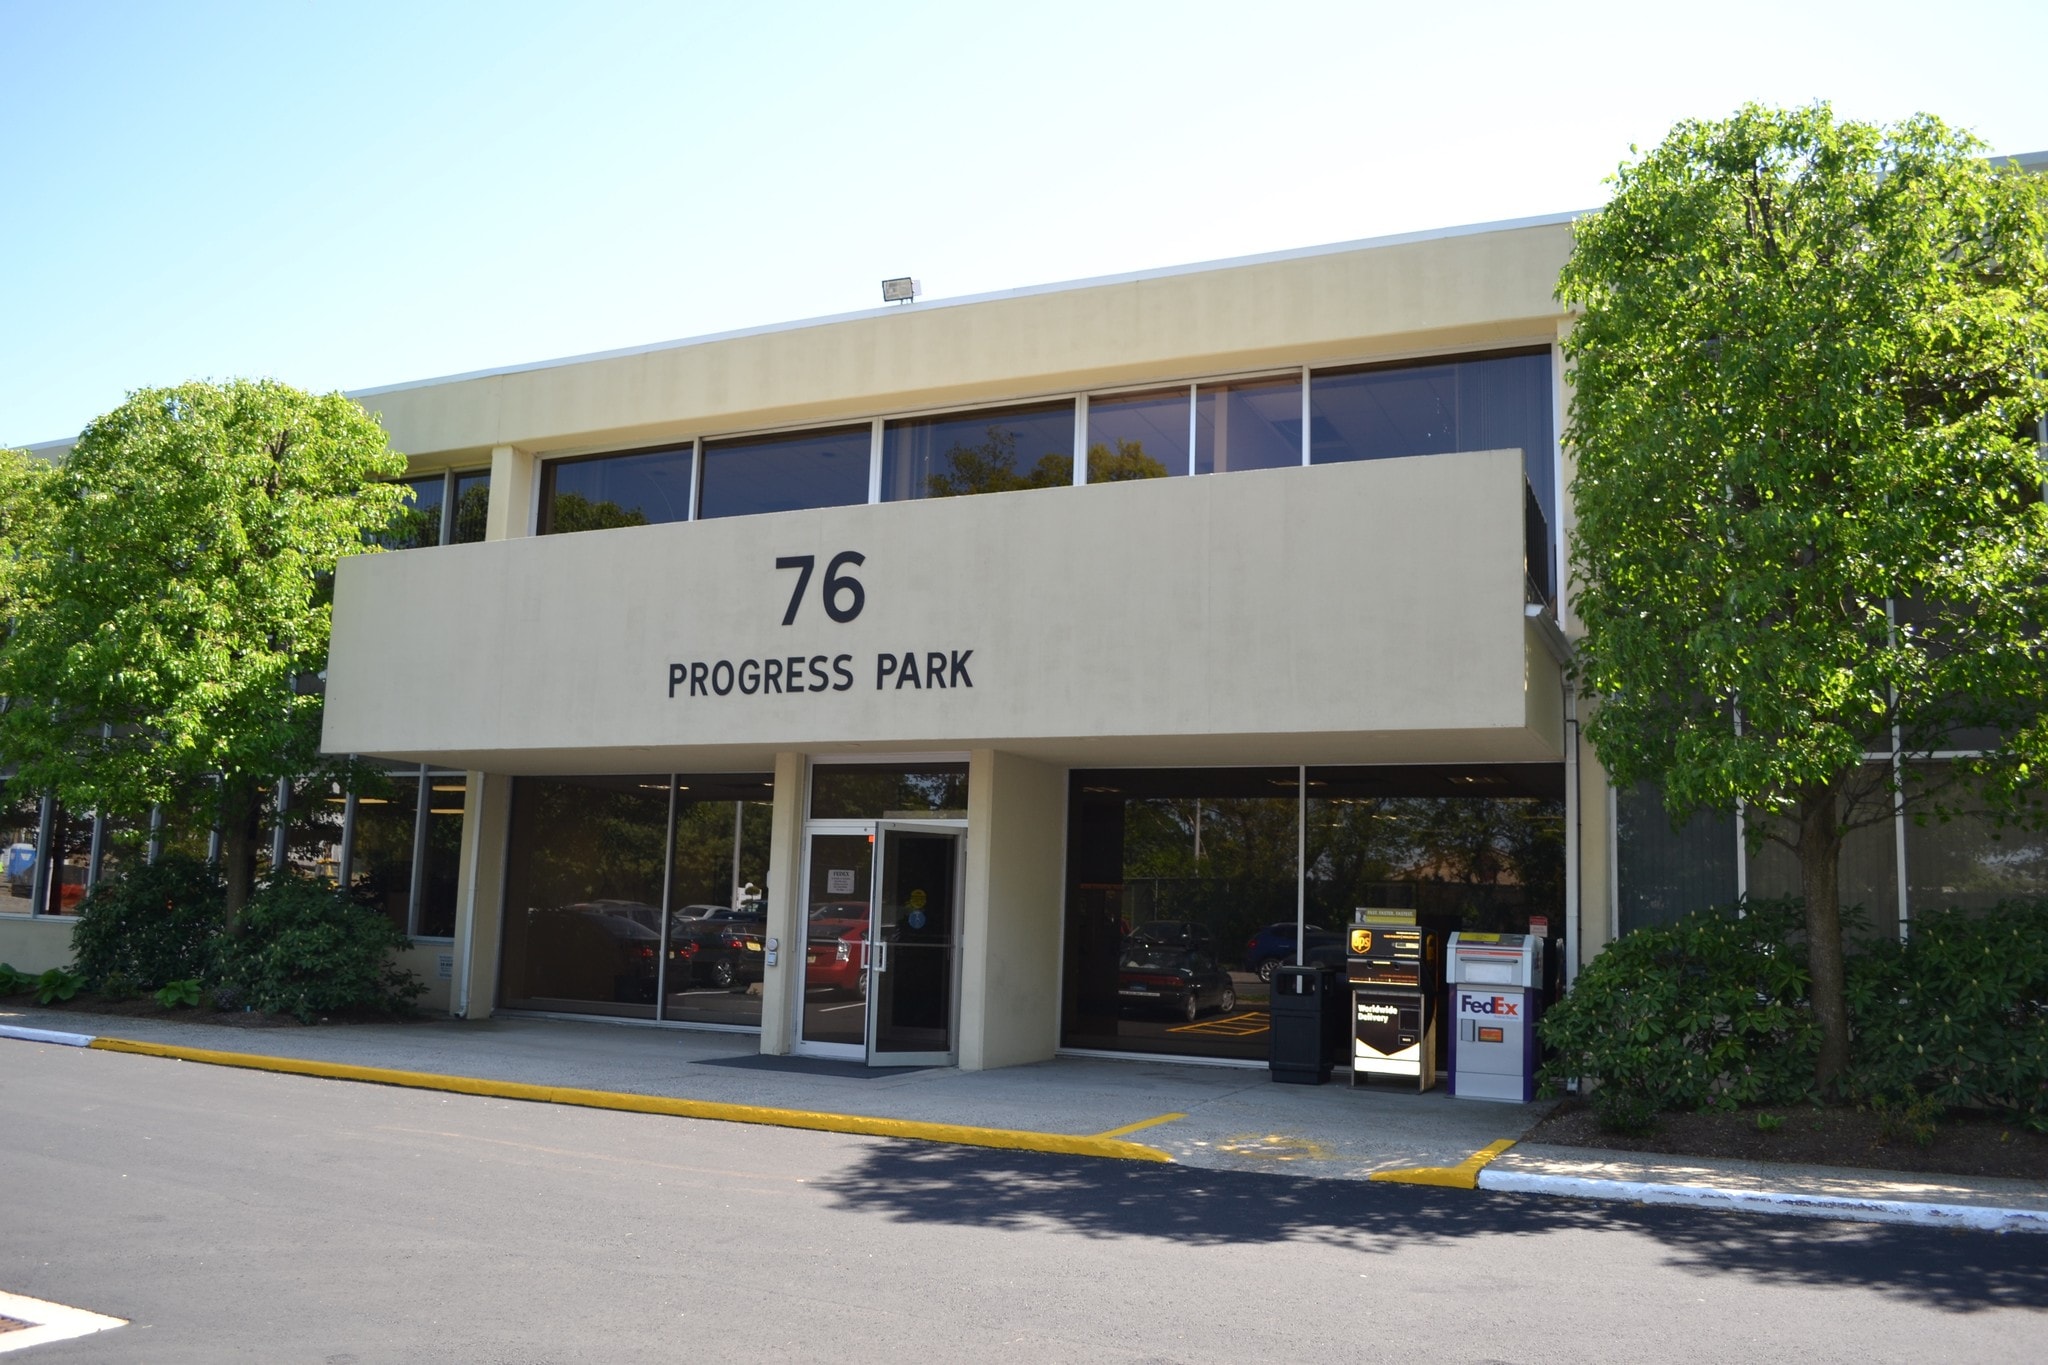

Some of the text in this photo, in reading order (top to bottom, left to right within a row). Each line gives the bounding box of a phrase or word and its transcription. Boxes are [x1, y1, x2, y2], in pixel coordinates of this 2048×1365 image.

[775, 550, 866, 626] 76
[668, 649, 974, 698] PROGRESS PARK
[1353, 937, 1370, 950] ups
[1357, 1004, 1398, 1015] Worldwide
[1461, 994, 1519, 1016] FedEx
[1357, 1012, 1389, 1024] Delivery
